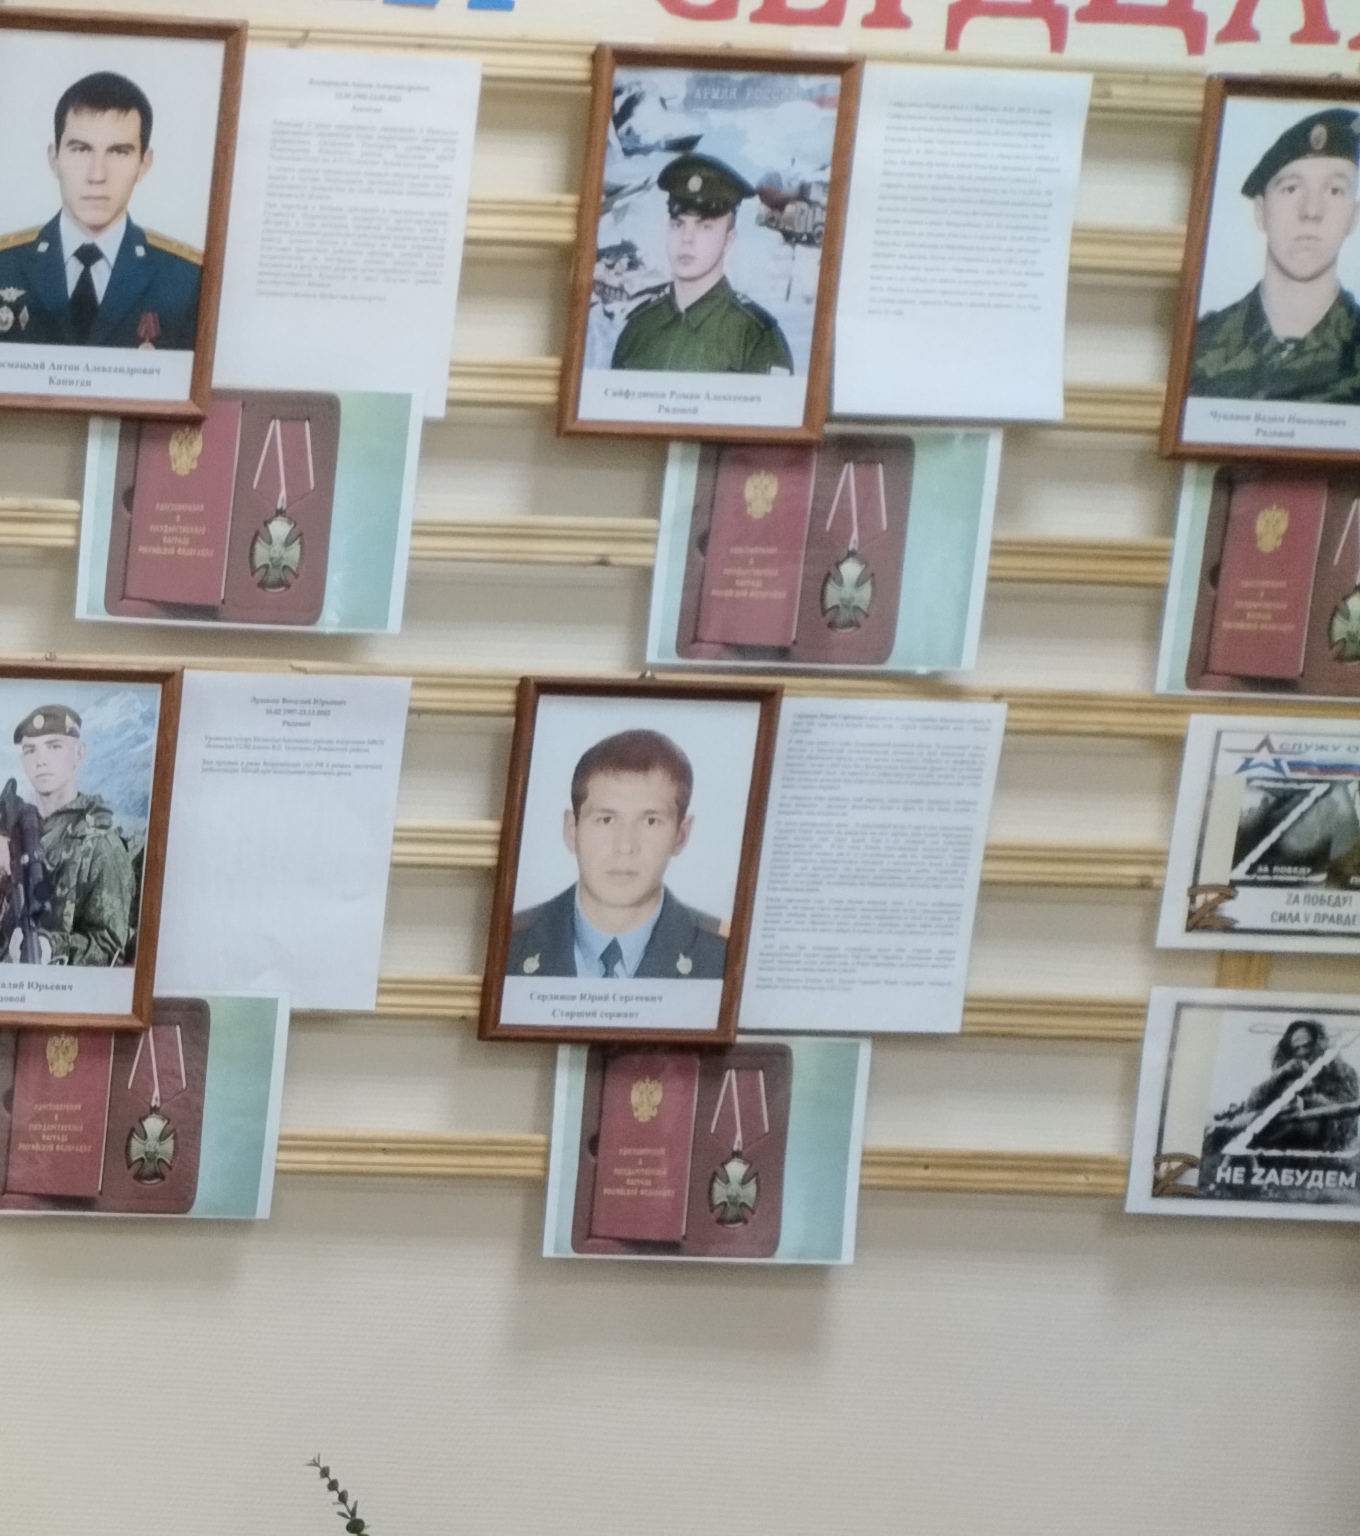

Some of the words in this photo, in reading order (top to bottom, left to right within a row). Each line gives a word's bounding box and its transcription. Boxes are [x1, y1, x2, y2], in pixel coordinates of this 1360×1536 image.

[49, 362, 80, 372] Антон
[1278, 743, 1340, 752] СЛУЖУ
[1270, 911, 1300, 923] СИЛА
[27, 981, 74, 992] Юрьевич
[612, 993, 663, 1004] Сергеевич
[552, 1008, 598, 1020] Старший
[599, 1011, 640, 1020] сержант
[1215, 1166, 1246, 1185] НЕ
[1250, 1167, 1357, 1189] ZАБУДЕМ
